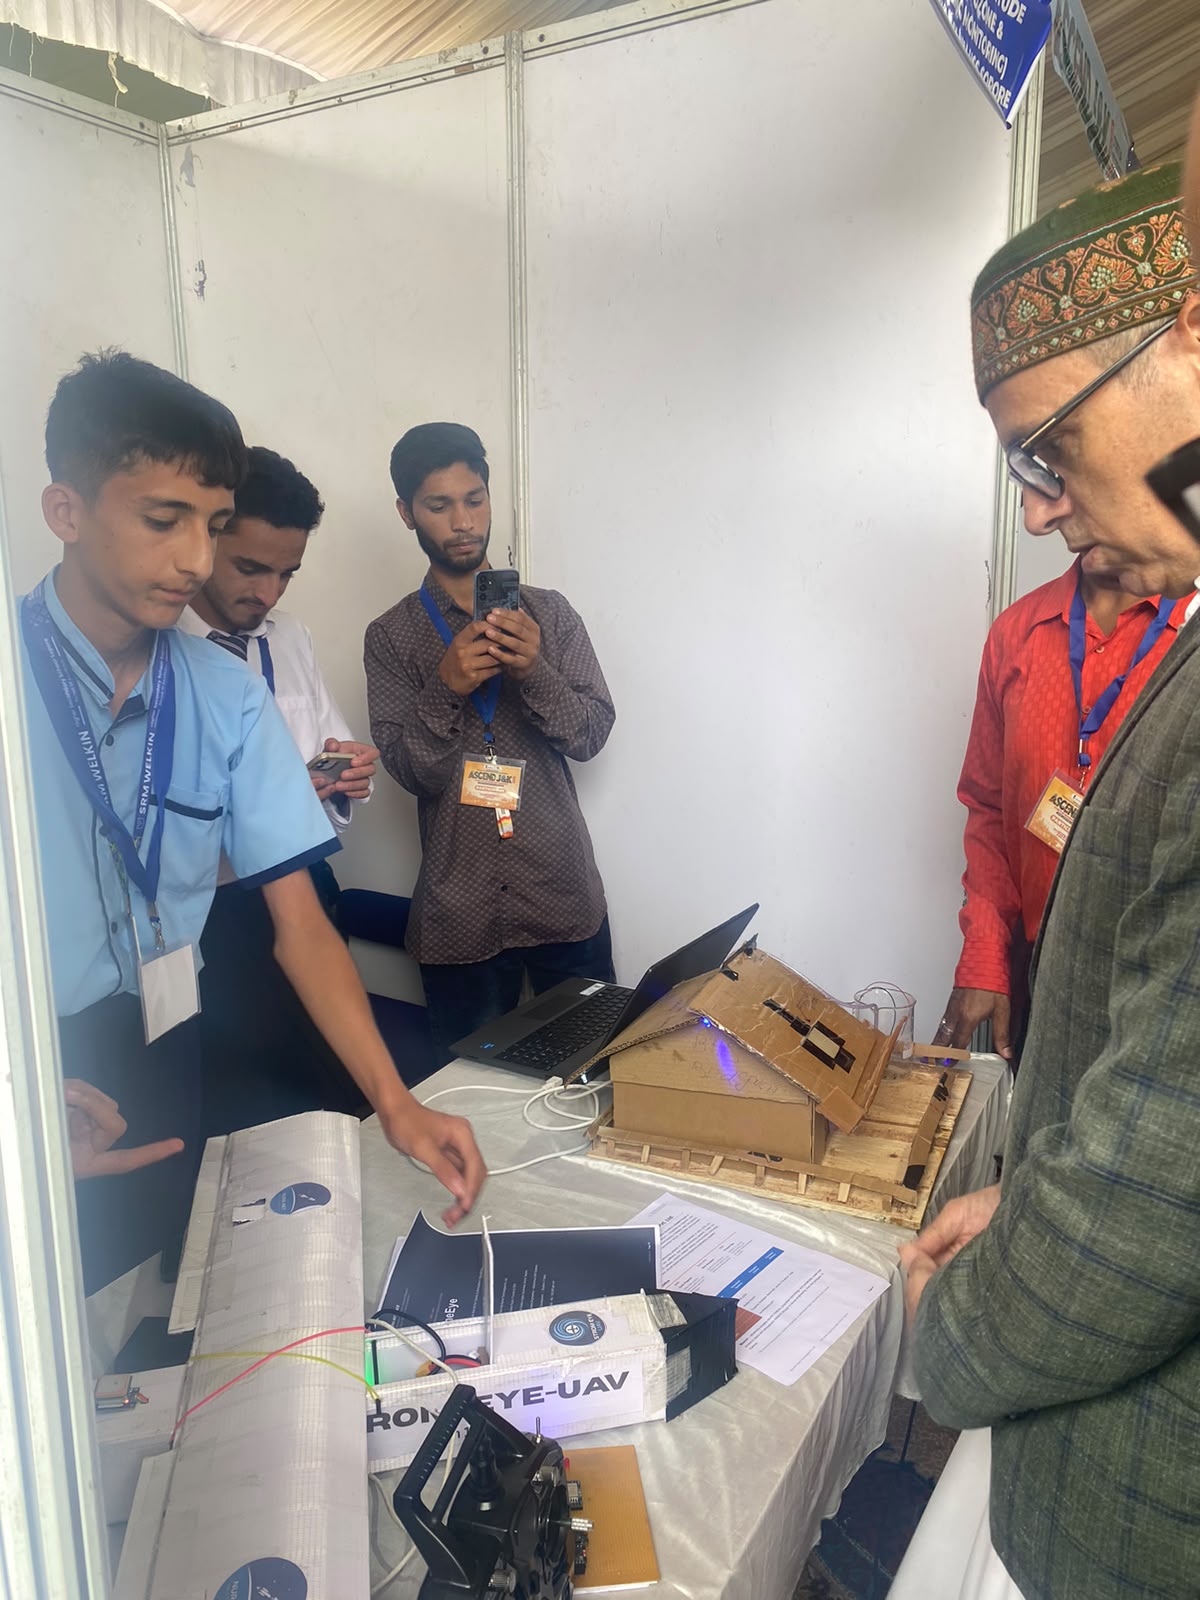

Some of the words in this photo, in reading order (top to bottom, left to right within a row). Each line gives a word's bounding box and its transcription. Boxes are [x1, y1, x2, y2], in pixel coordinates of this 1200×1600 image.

[78, 730, 103, 782] WELKIN
[143, 732, 156, 783] WELKIN
[468, 770, 497, 782] ASCEND
[139, 784, 151, 815] SRM
[476, 1370, 630, 1410] EYE-UAV
